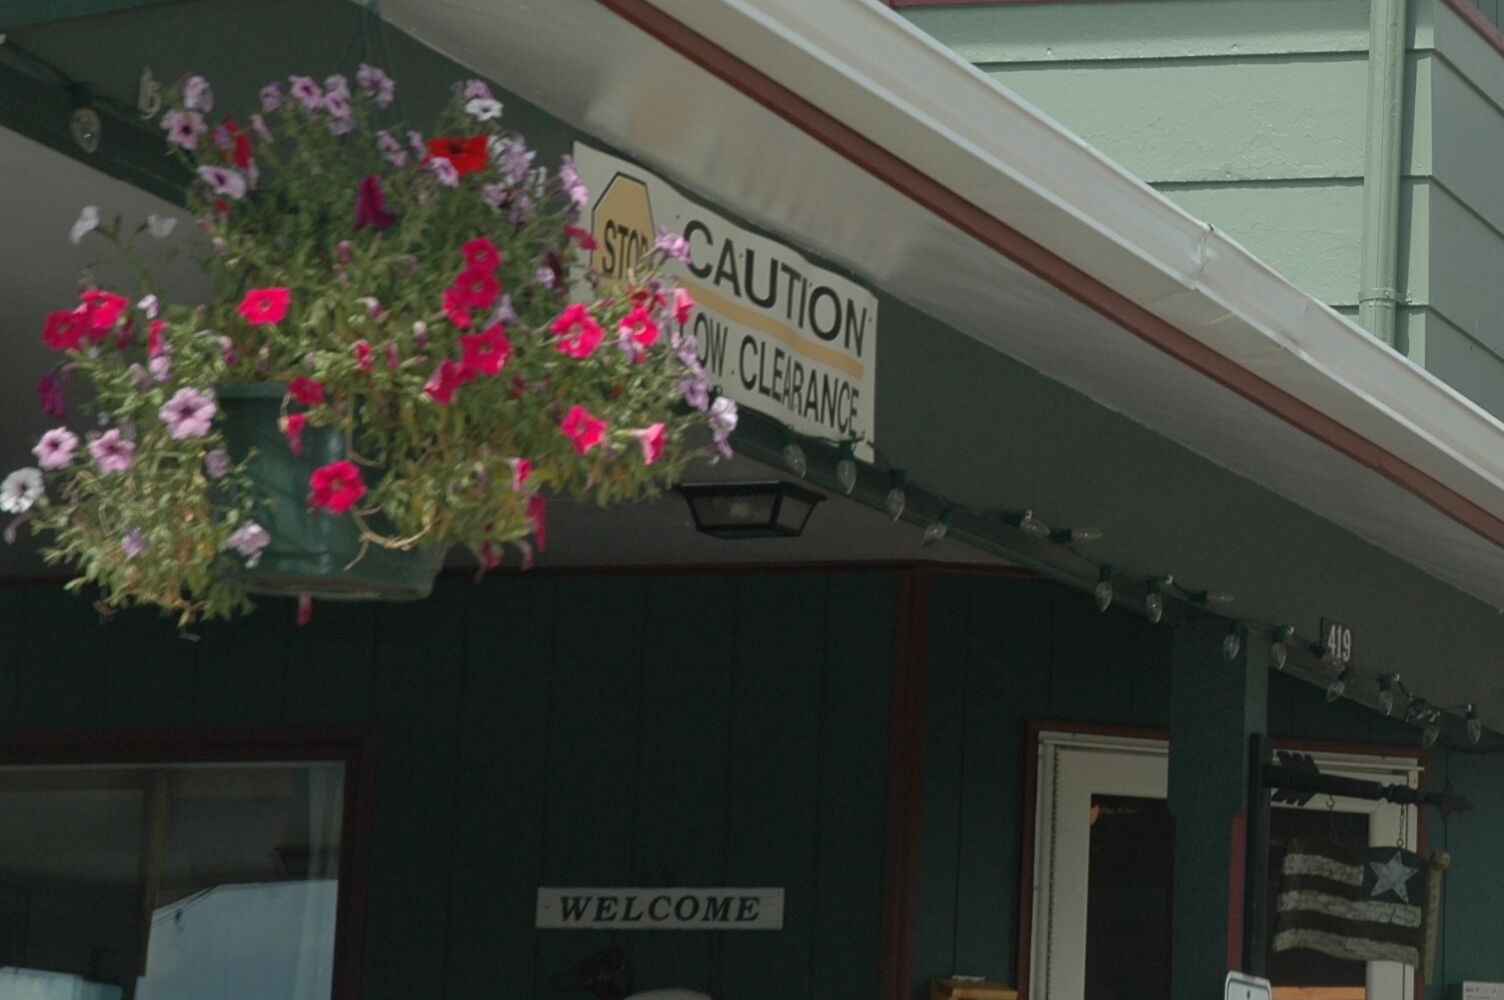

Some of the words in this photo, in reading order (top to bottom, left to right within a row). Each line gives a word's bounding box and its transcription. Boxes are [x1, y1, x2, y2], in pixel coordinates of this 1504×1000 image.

[682, 219, 868, 358] CAUTION
[678, 311, 729, 378] OW
[738, 335, 860, 437] CLEARANCE
[1327, 623, 1352, 663] 419
[559, 895, 761, 922] WELCOME
